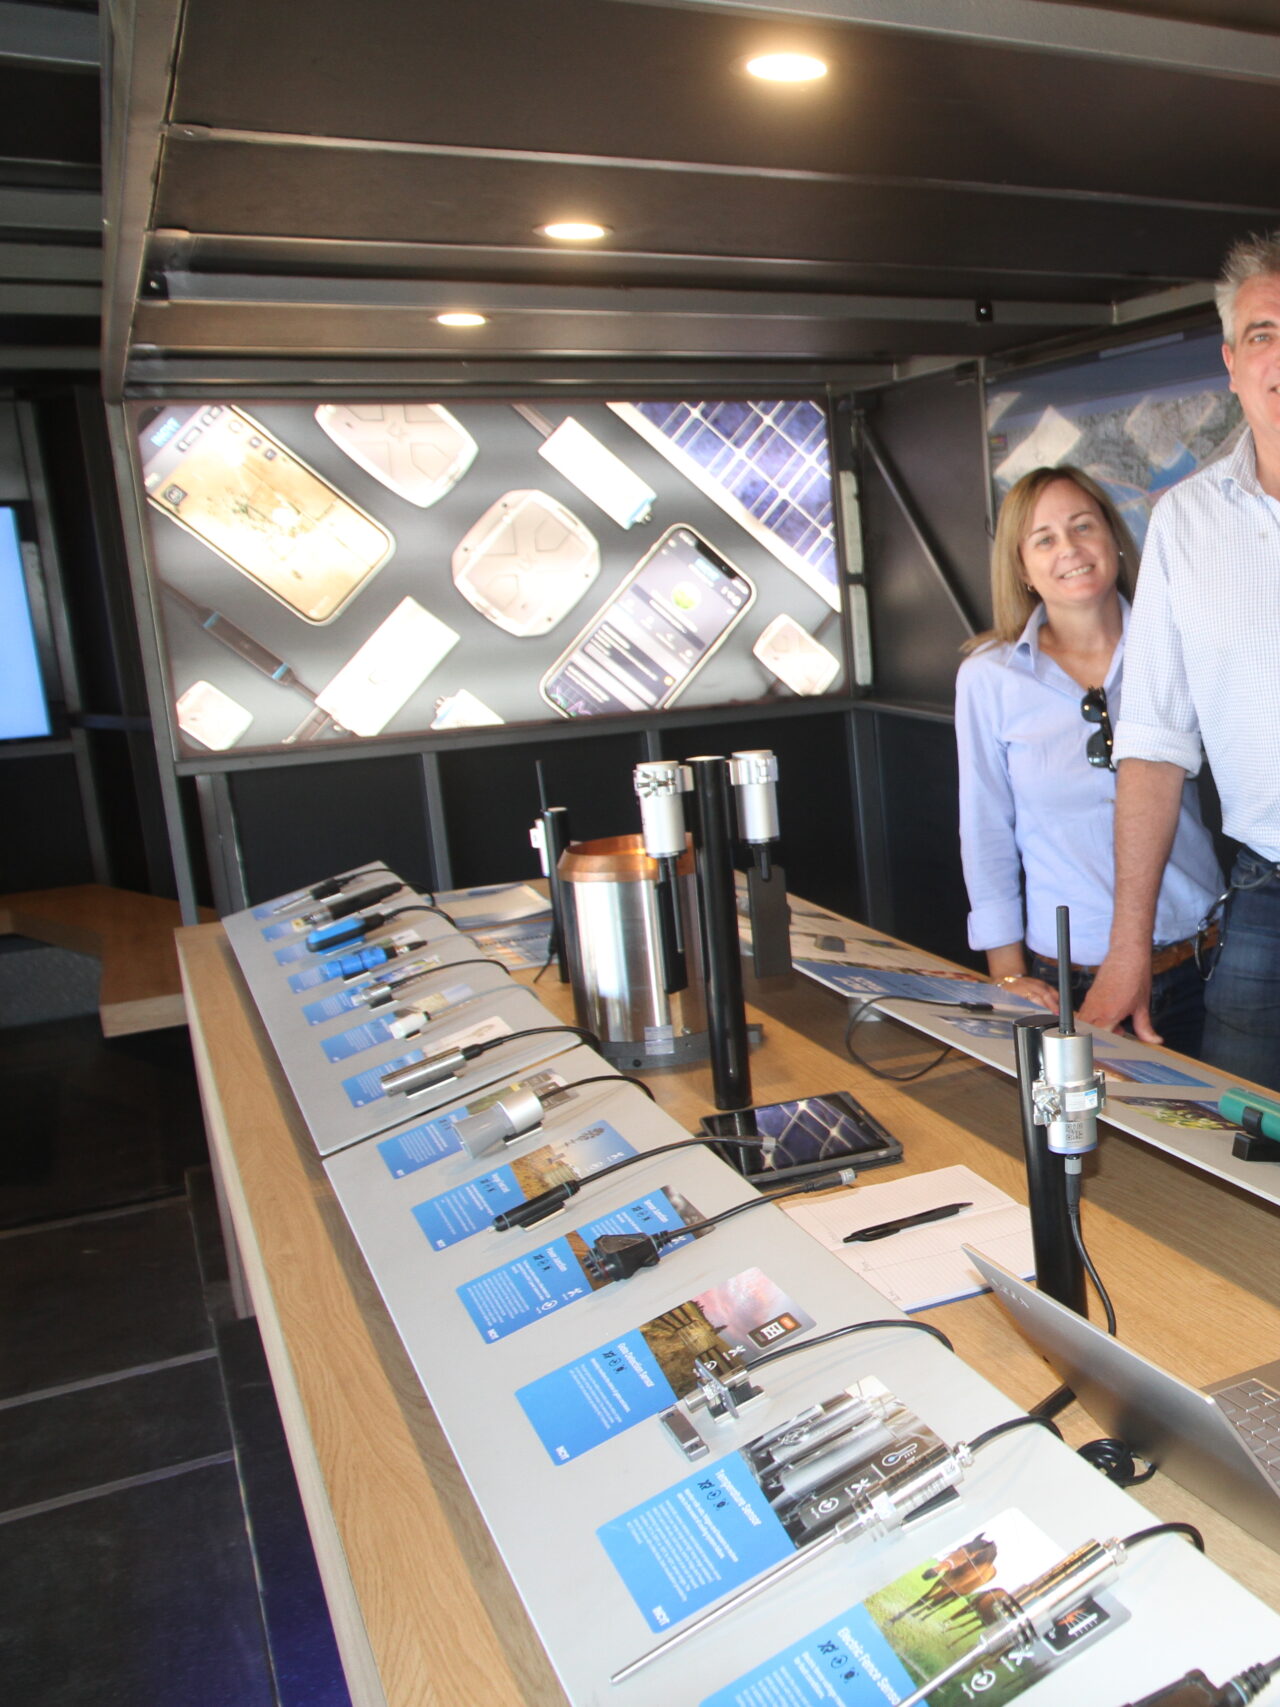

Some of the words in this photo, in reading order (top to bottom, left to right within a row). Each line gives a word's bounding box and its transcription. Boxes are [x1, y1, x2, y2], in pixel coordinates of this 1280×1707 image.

[715, 1469, 746, 1507] Temperature
[837, 1626, 864, 1658] Electric
[858, 1653, 882, 1681] Fence
